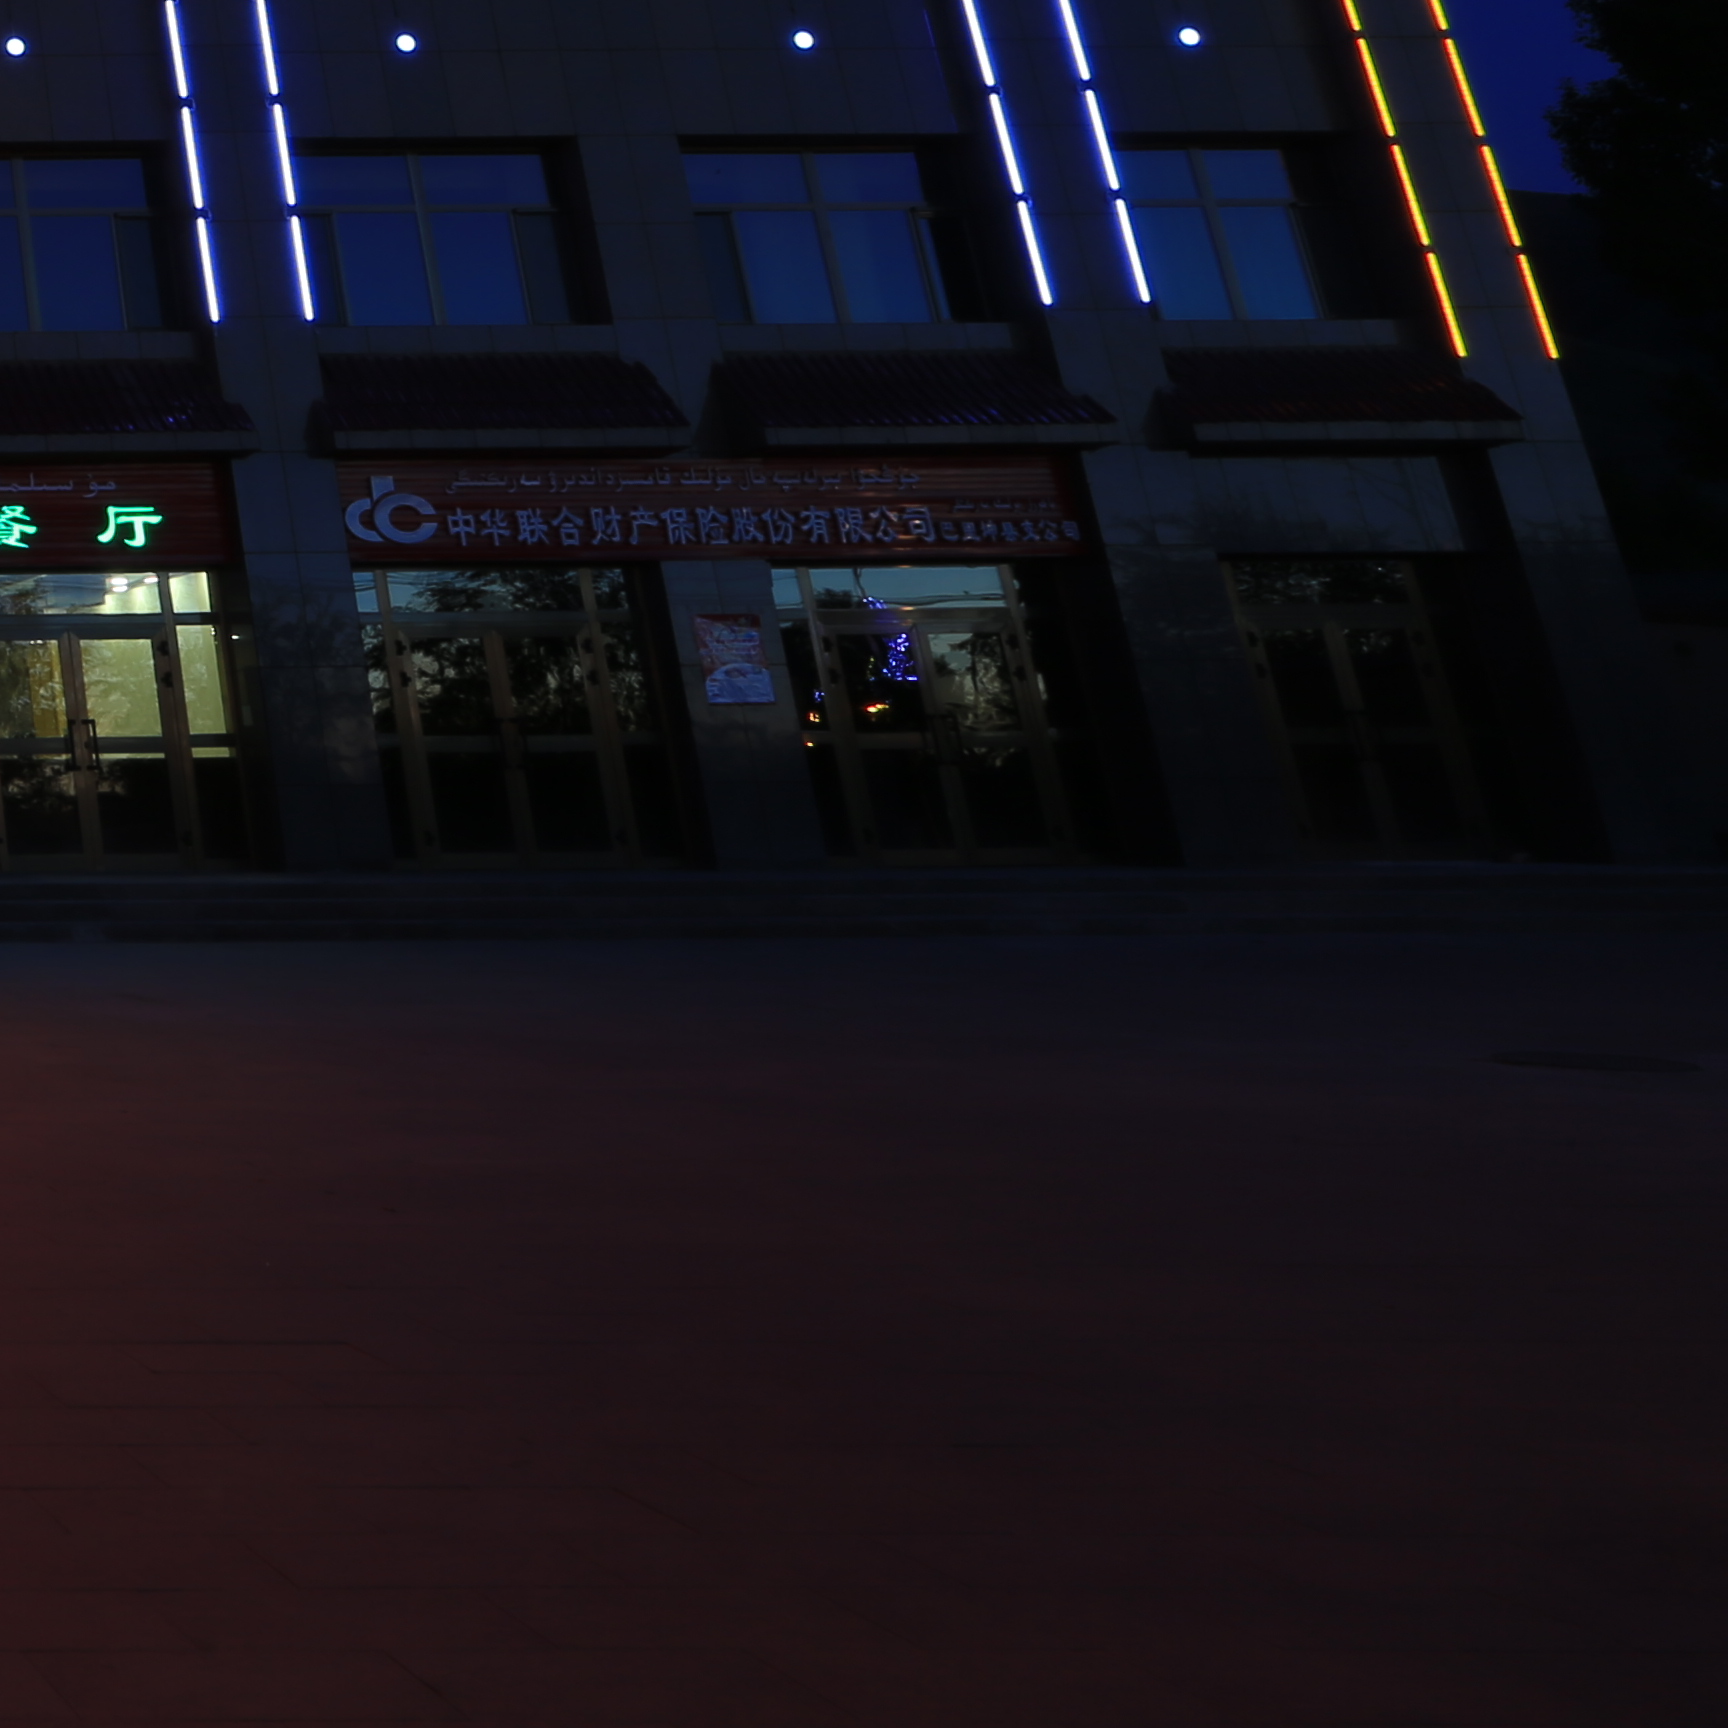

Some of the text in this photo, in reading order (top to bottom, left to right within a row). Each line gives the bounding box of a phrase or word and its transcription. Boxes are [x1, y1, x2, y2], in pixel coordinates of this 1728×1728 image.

[446, 505, 937, 546] 中华联合财产保险股份有限公司
